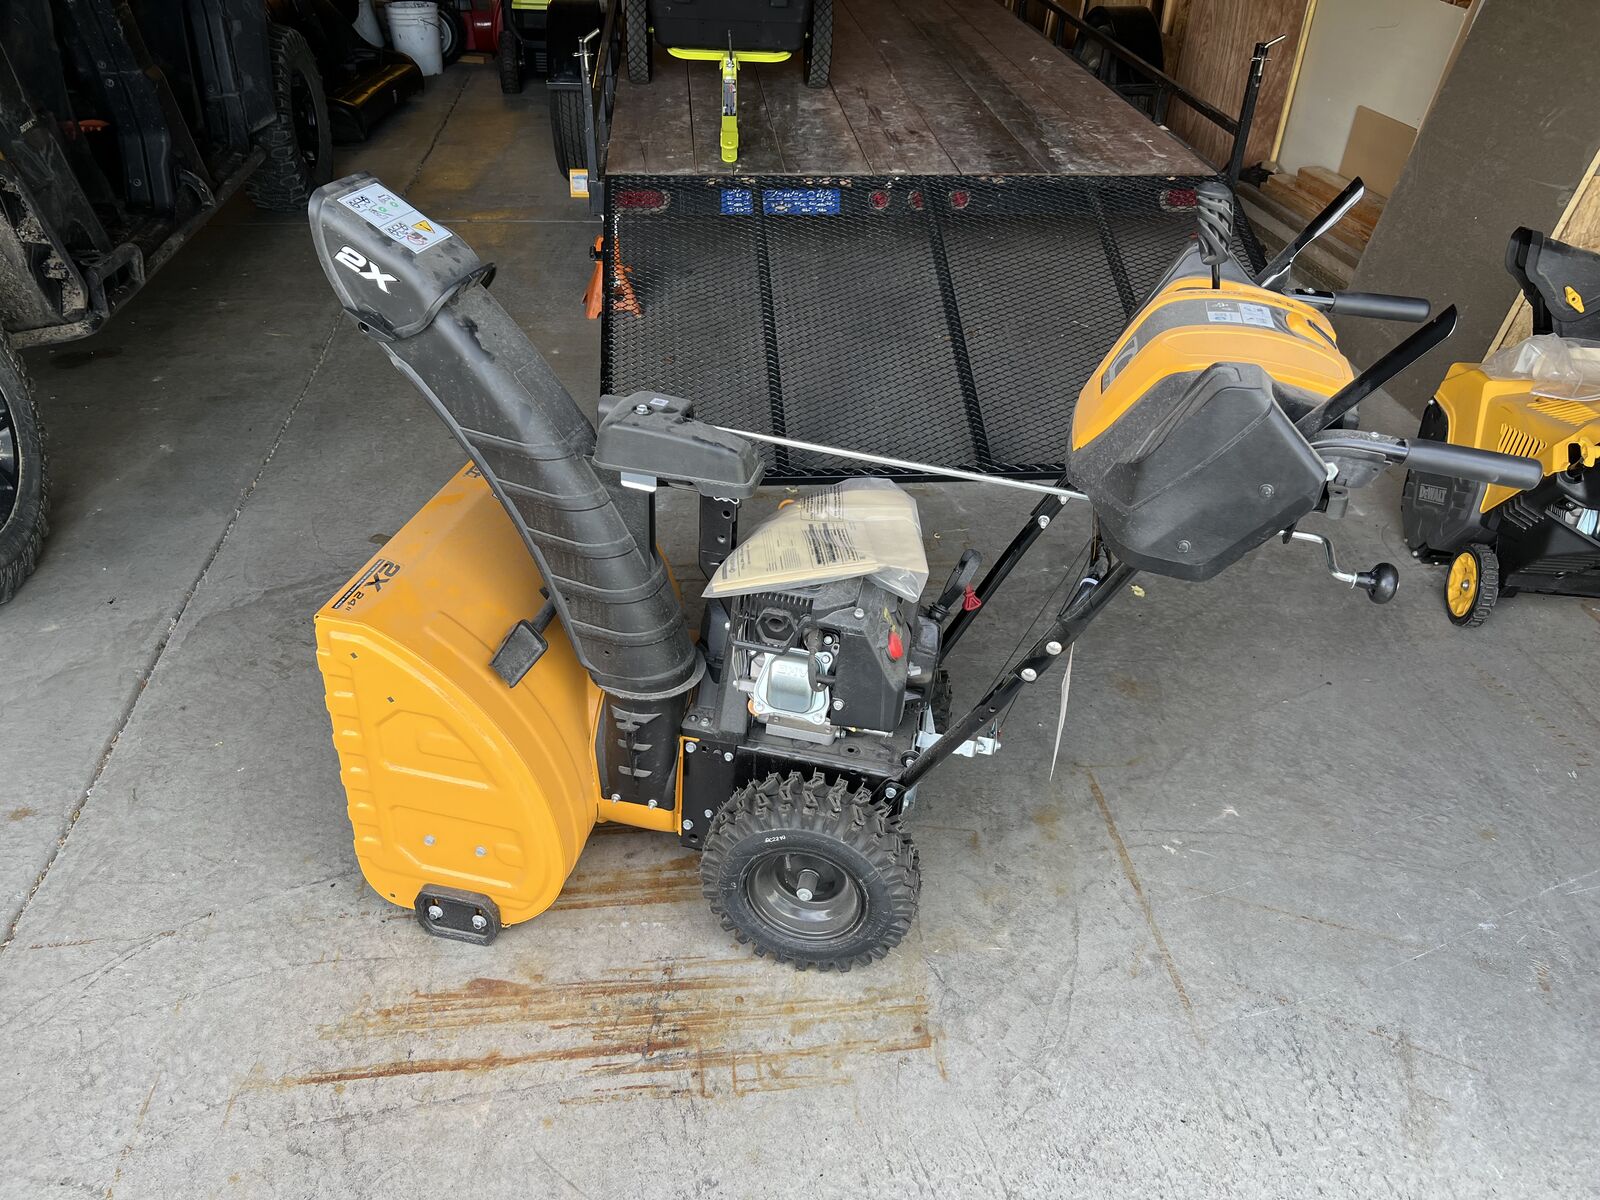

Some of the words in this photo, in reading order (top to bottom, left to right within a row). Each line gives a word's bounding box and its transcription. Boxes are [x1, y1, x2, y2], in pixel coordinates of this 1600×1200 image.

[334, 245, 400, 295] 2X
[1418, 484, 1448, 503] DeWALT
[364, 560, 401, 592] 2X
